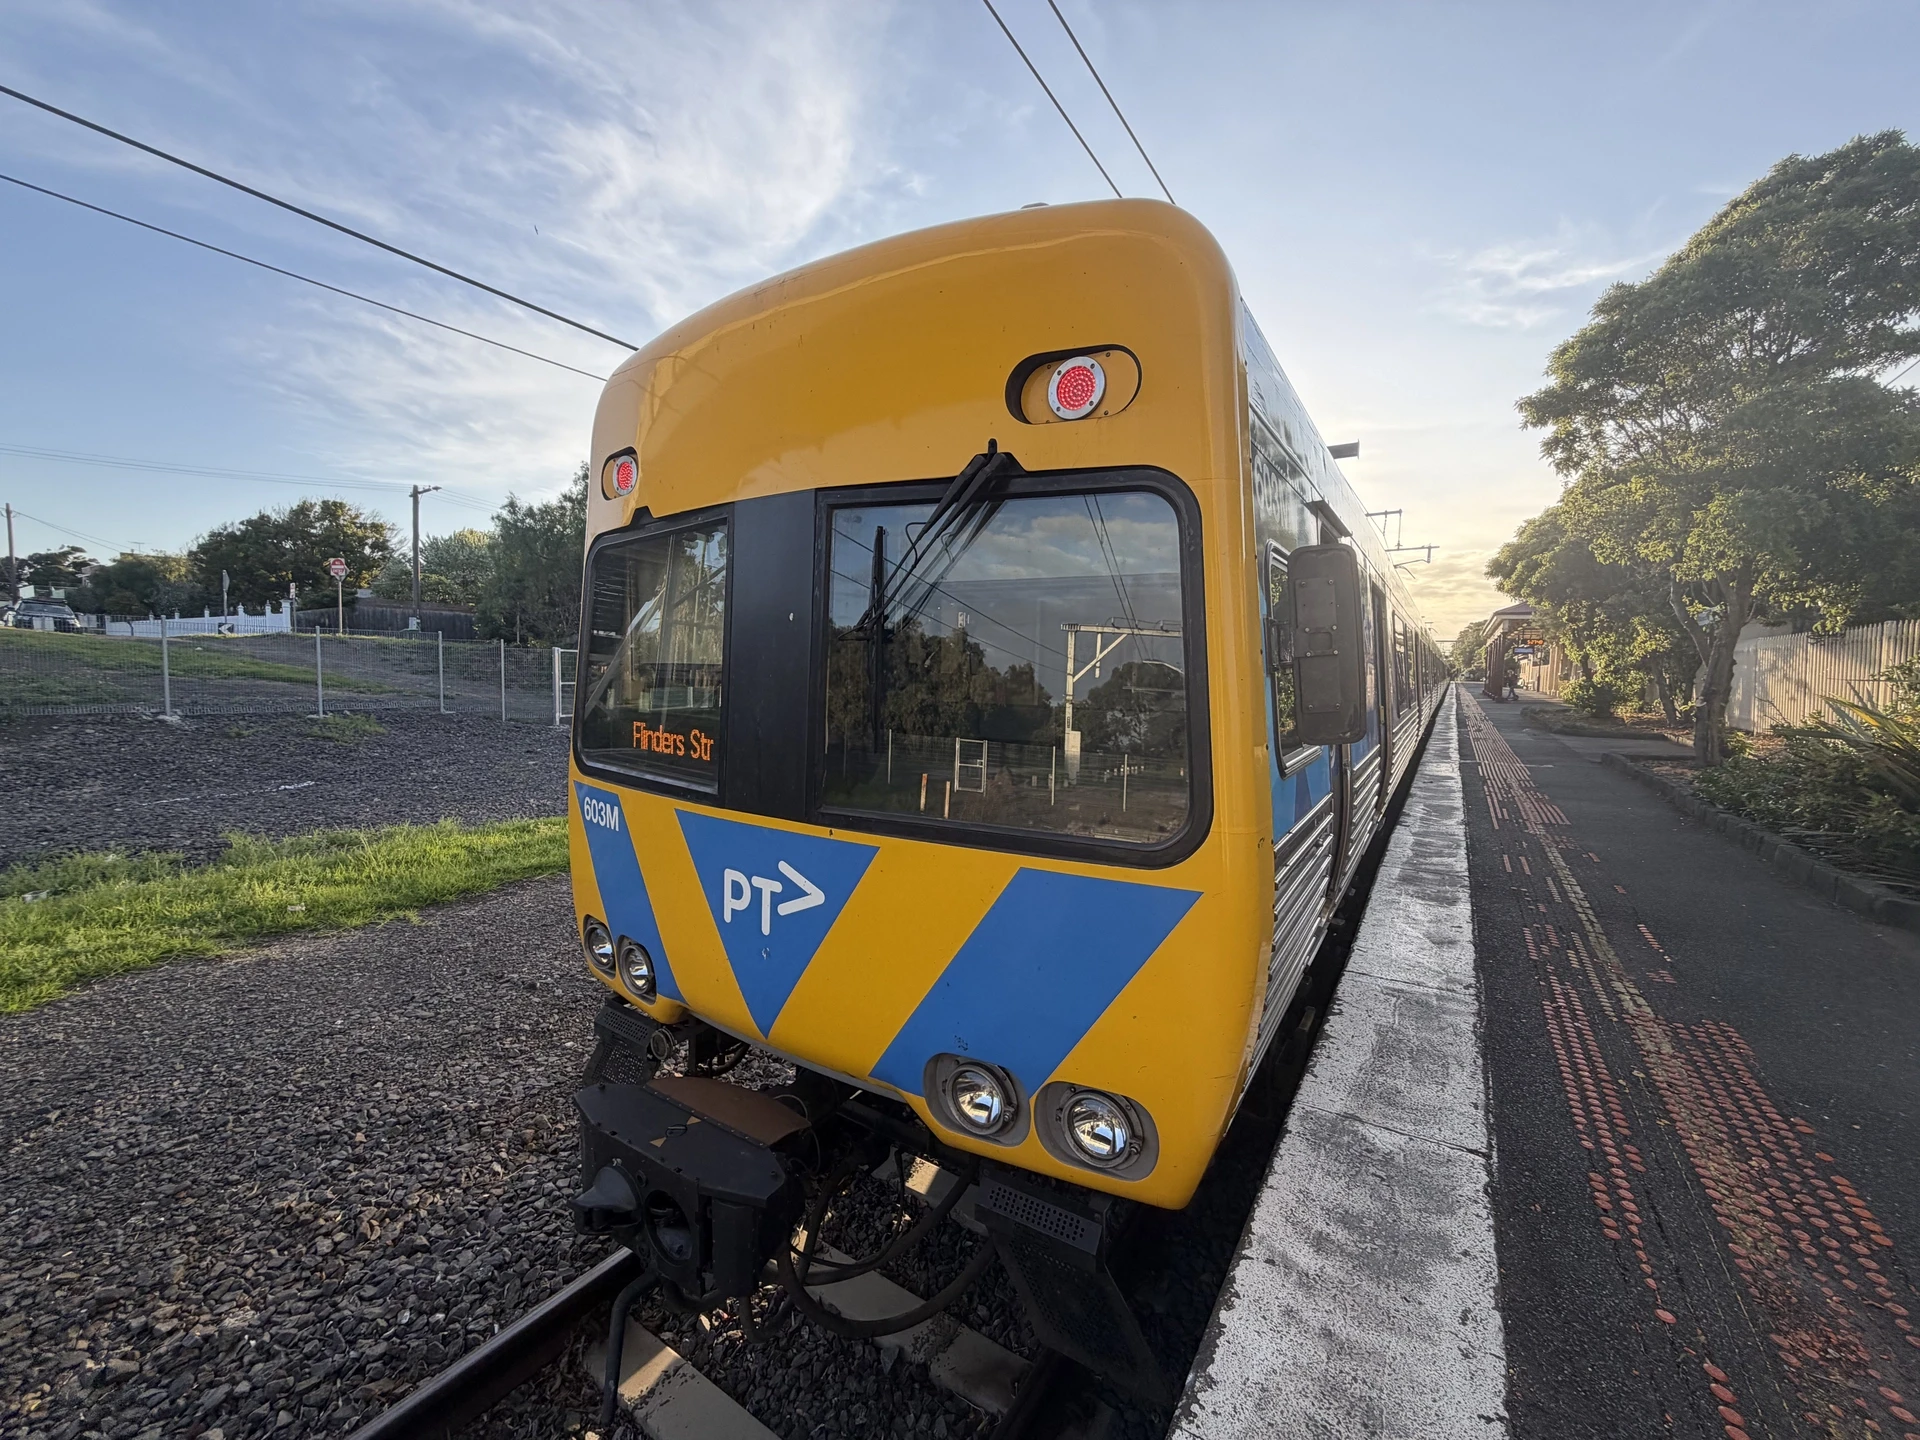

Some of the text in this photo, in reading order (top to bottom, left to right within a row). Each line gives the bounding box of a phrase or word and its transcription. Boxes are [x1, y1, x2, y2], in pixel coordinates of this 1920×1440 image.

[633, 721, 714, 761] Flinders Str
[584, 796, 619, 832] 603M
